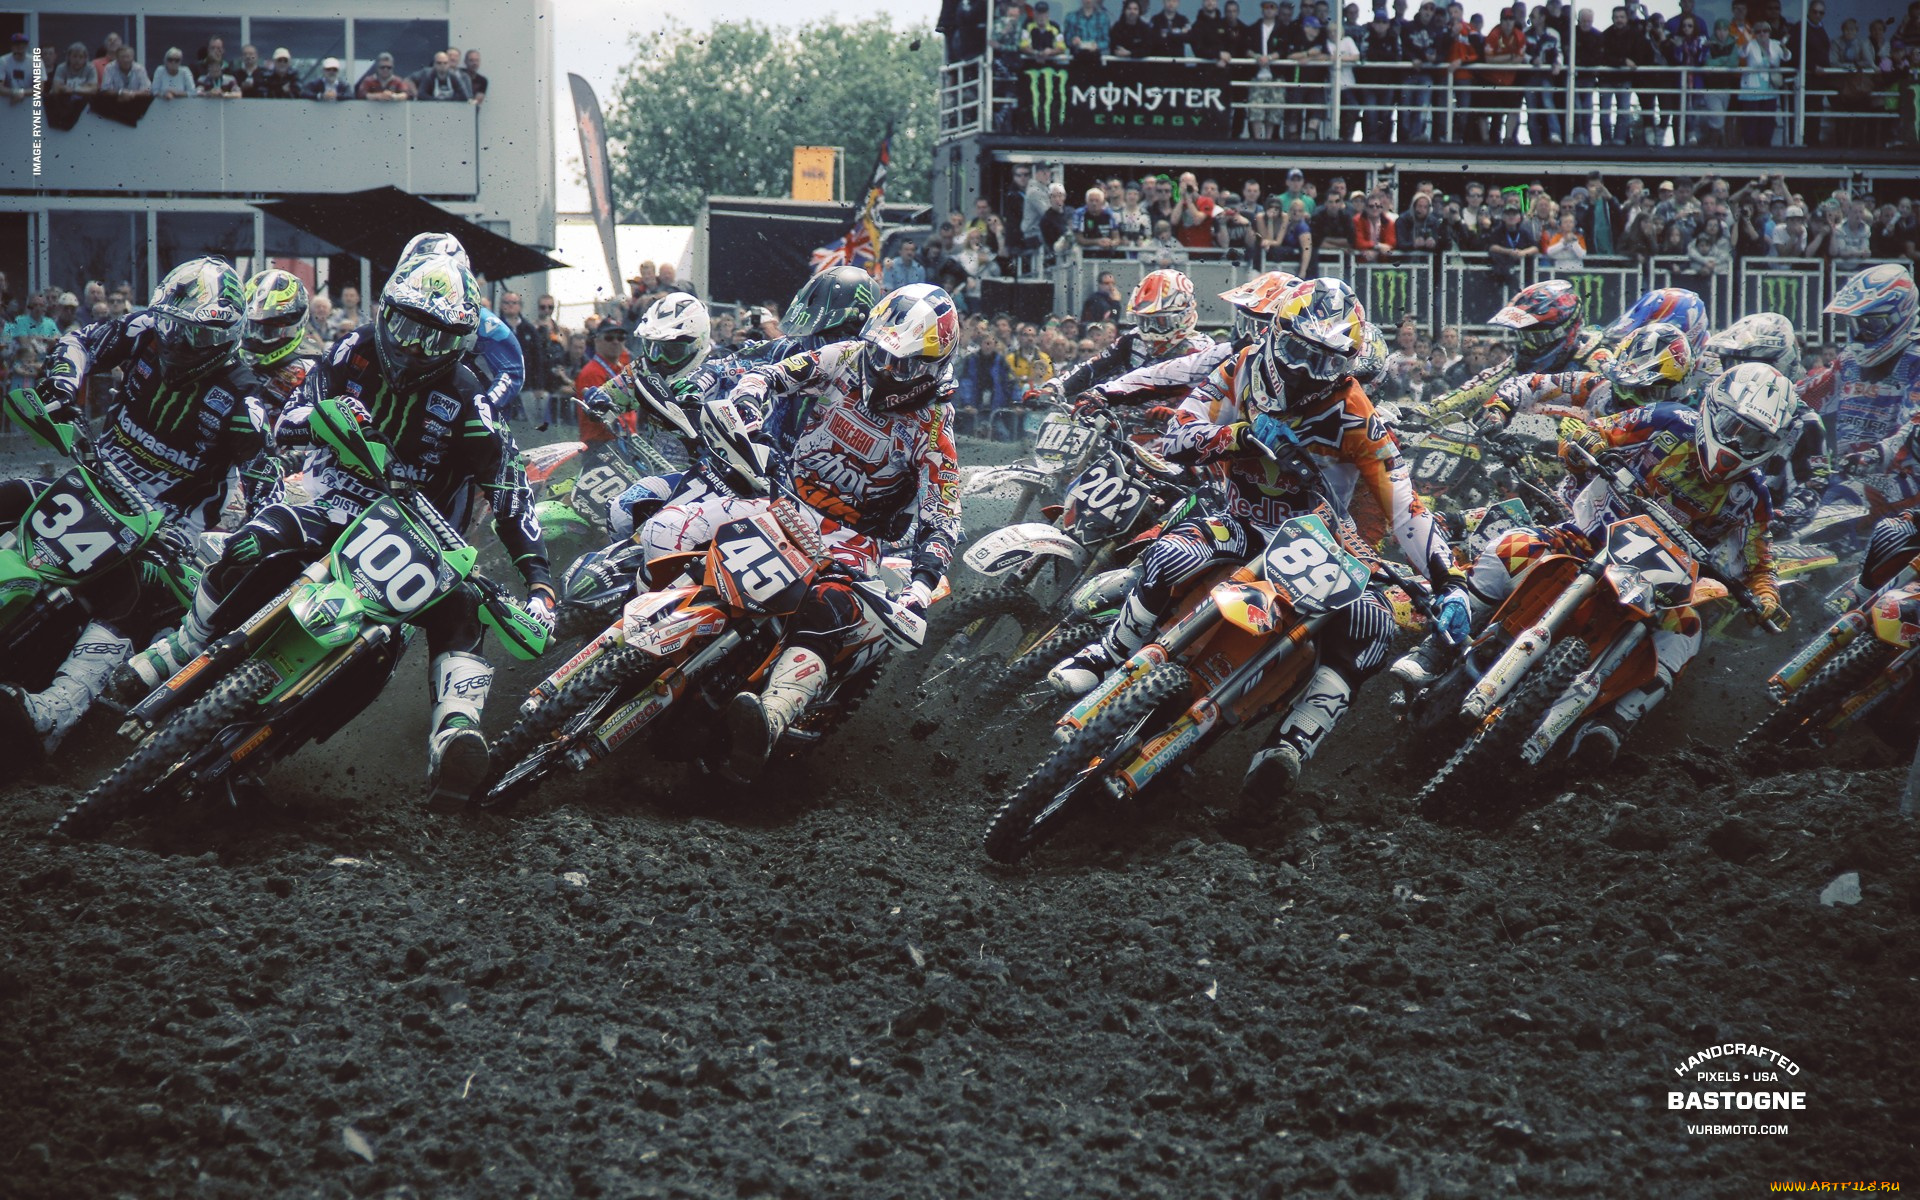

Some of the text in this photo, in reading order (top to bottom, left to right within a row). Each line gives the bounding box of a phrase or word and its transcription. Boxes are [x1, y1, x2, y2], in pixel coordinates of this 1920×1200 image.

[1094, 113, 1203, 127] ENERGY
[857, 402, 887, 427] WILVO
[113, 423, 195, 480] PRO CIRCUIT
[117, 404, 201, 472] Kawasaki
[1037, 423, 1091, 455] 103
[575, 465, 628, 504] 60
[800, 450, 874, 503] shot
[1415, 450, 1461, 483] 91
[1070, 466, 1141, 524] 202
[1226, 482, 1271, 525] Red
[32, 493, 117, 574] 34
[35, 536, 65, 565] Kawasaki
[407, 529, 436, 560] MONSTER
[342, 516, 437, 613] 100
[585, 562, 615, 589] YAMAHA
[718, 535, 798, 603] 45
[1267, 537, 1352, 602] 89
[1614, 530, 1694, 586] 17
[353, 567, 385, 600] Kawasaki
[1290, 586, 1301, 599] BAY
[240, 588, 293, 633] PRO CIRCUIT
[73, 642, 126, 658] TCX
[661, 641, 681, 654] WILVO
[1793, 636, 1829, 670] MOTOREX
[455, 673, 493, 695] TCX
[1080, 673, 1126, 710] MOTOREX
[1153, 728, 1197, 767] MOTOREX
